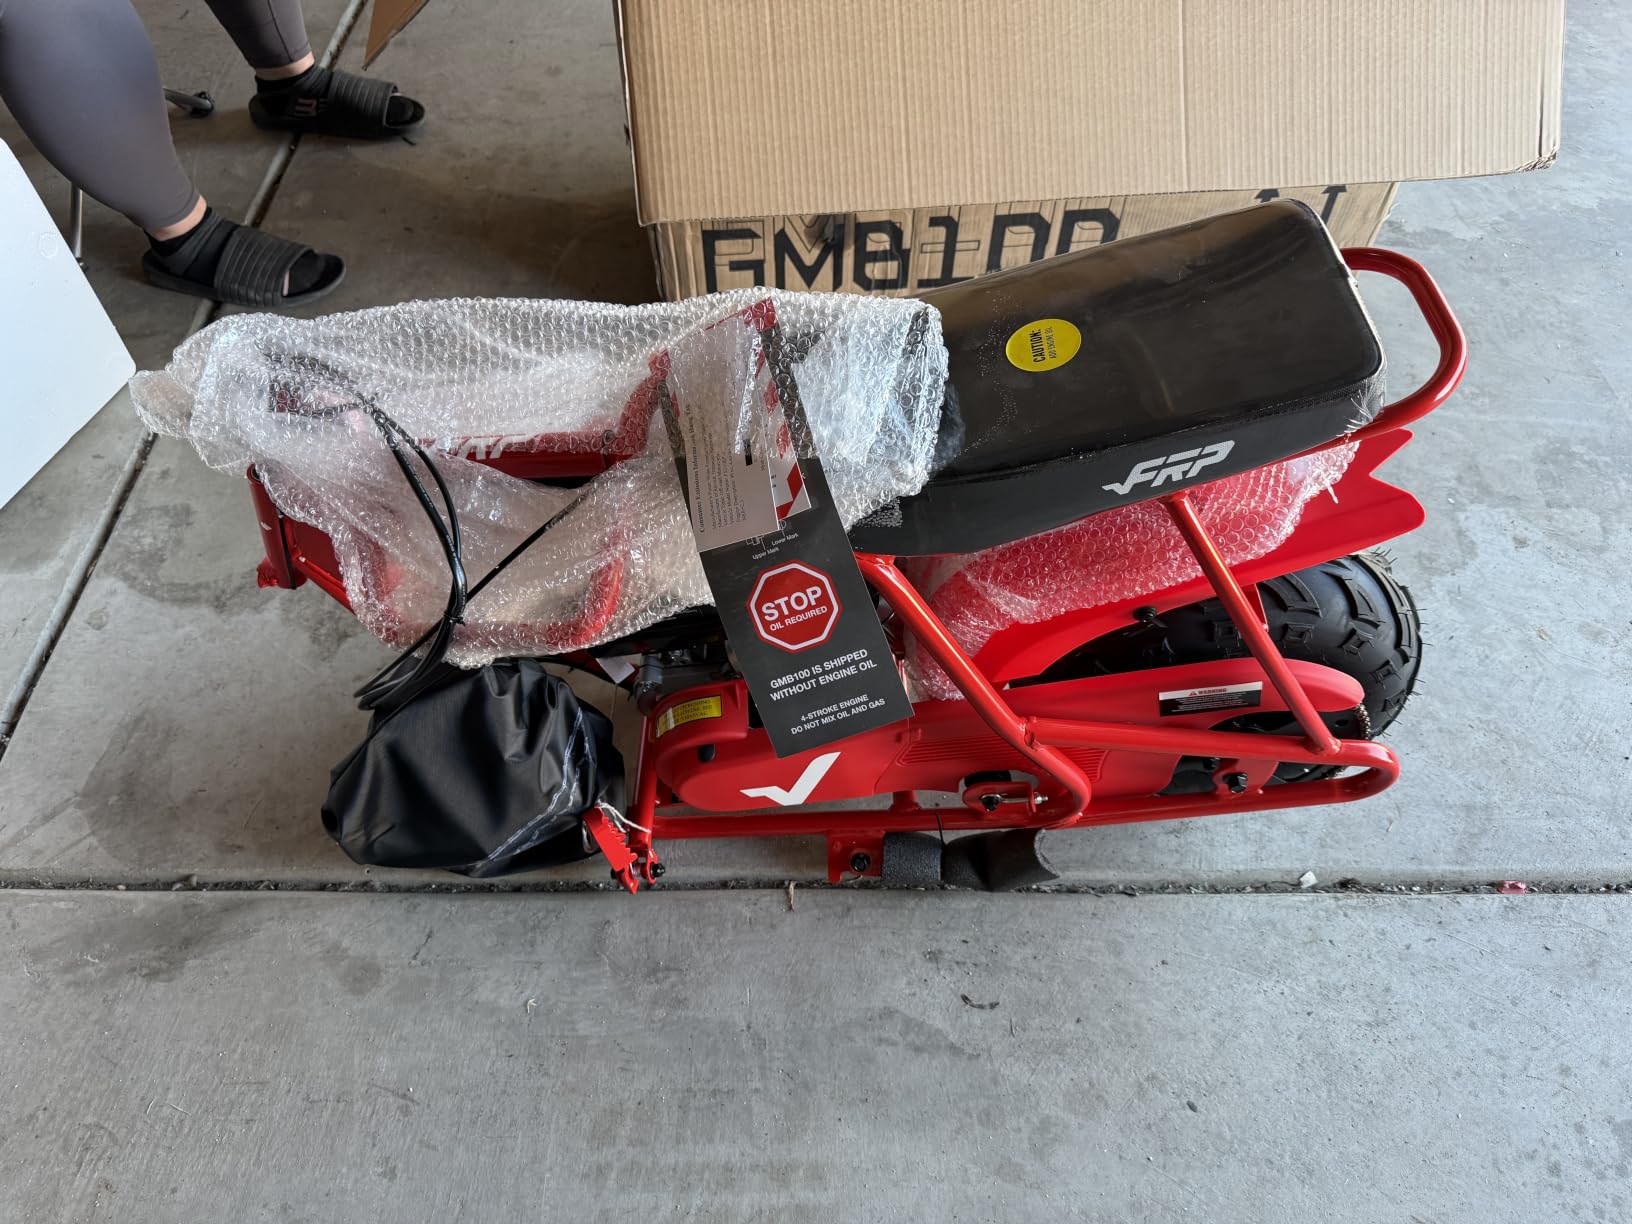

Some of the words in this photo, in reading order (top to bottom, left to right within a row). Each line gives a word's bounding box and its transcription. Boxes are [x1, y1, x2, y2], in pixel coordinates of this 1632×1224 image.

[1029, 329, 1045, 363] CAUTION:
[1102, 440, 1235, 495] FRP
[761, 585, 822, 621] STOP
[769, 622, 785, 632] OIL
[784, 605, 828, 627] REQUIRED
[770, 669, 811, 689] GMB100
[812, 664, 822, 675] IS
[823, 649, 868, 670] SHIPPED
[770, 679, 817, 702] WITHOUT
[818, 665, 858, 686] ENGINE
[858, 659, 877, 671] OIL
[791, 725, 803, 735] DO
[803, 719, 820, 731] NOT
[821, 715, 837, 725] MIX
[836, 711, 851, 720] OIL
[851, 705, 868, 715] AND
[868, 698, 886, 709] GAS
[801, 704, 839, 722] 4-STROKE
[840, 694, 869, 709] ENGINE
